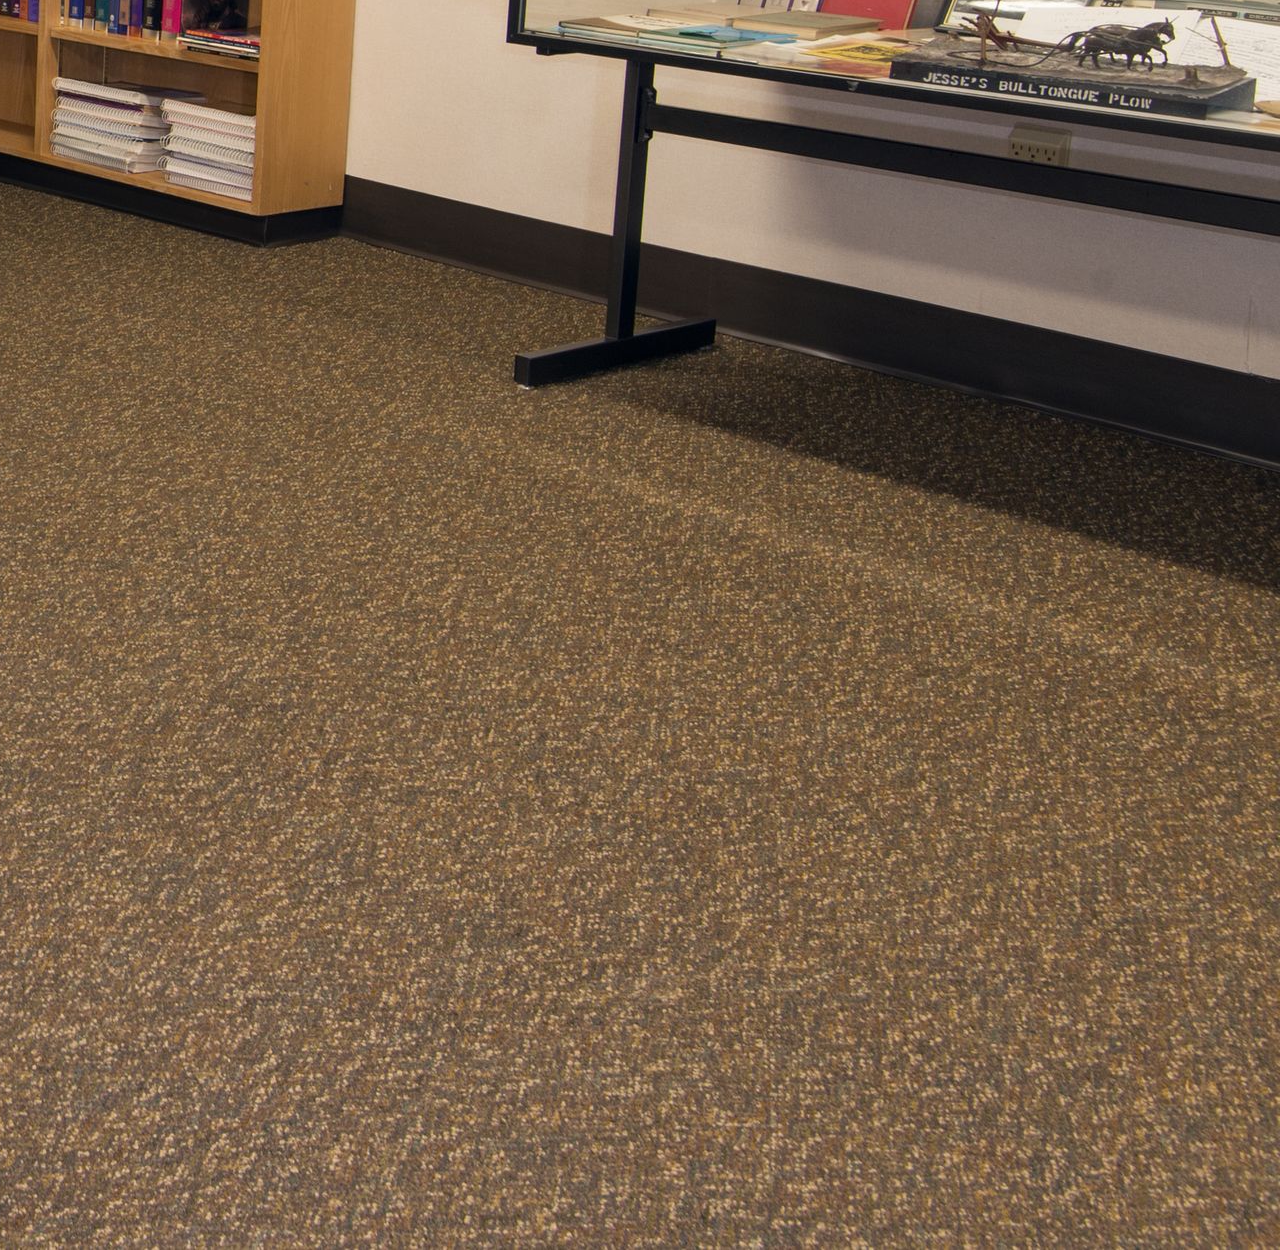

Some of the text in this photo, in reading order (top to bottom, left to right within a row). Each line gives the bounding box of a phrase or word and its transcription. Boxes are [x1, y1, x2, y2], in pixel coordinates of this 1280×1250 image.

[923, 72, 1153, 110] JESSE'S BULLTONGUE PLOW
